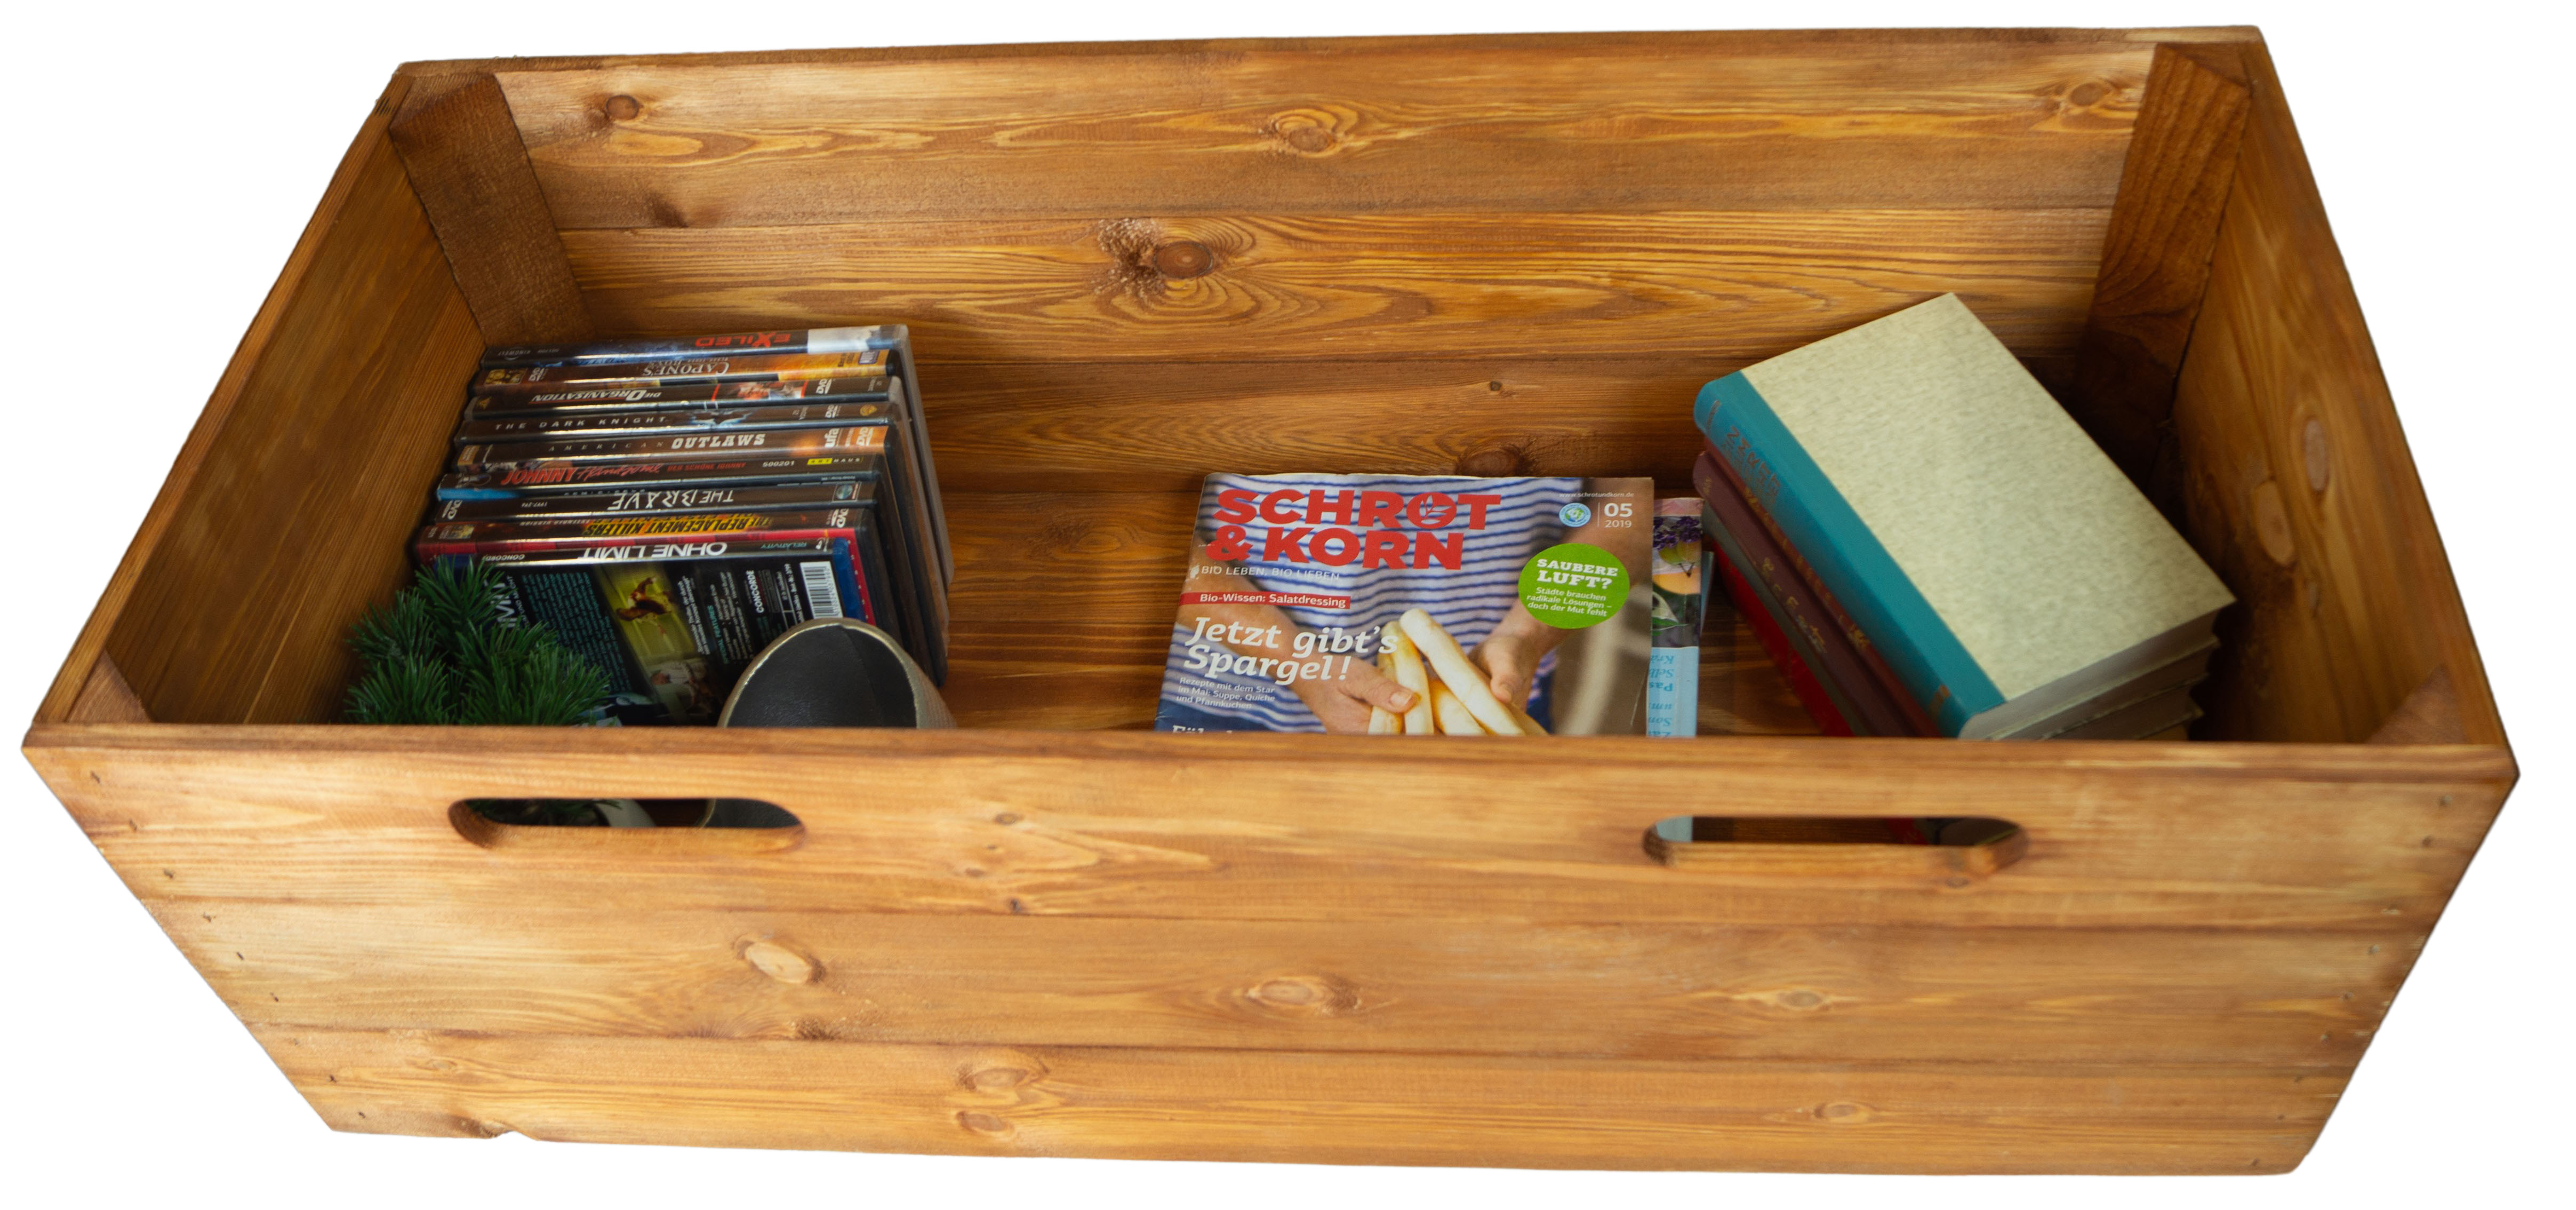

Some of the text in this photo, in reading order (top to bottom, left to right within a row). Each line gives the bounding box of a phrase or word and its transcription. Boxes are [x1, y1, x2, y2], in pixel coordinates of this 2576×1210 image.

[694, 331, 791, 347] EXILED
[531, 389, 647, 402] ORGANISATION
[495, 416, 667, 430] THE DARK KNIGHT
[548, 433, 766, 452] AMERICAN OUTLAWS
[762, 460, 796, 468] 500201
[500, 466, 580, 486] JOHNNY
[607, 490, 697, 511] BRAVE
[699, 490, 734, 504] THE
[1212, 489, 1501, 530] SCHROT
[1604, 503, 1633, 518] 05
[586, 521, 645, 536] KILLERS
[648, 517, 748, 534] REPLACEMENT
[1604, 520, 1633, 528] 2019
[578, 542, 728, 560] OHNE LIMIT
[1205, 524, 1464, 570] & KORN
[1201, 566, 1222, 575] BIO
[1271, 568, 1295, 578] BIO
[1296, 569, 1340, 582] LIEBEN
[1536, 559, 1619, 577] SAUBERE
[1537, 570, 1613, 590] LUFT?
[746, 570, 764, 614] CONCORDE
[1535, 586, 1607, 602] Städte brauchen
[1199, 593, 1347, 609] Bio-Wissen: Salatdressing
[1526, 595, 1563, 604] radikale
[1563, 597, 1605, 609] Lösungen
[1527, 601, 1608, 617] doch der Mut fehlt
[1185, 616, 1282, 649] Jetzt
[1179, 676, 1276, 694] Rezepte mit dem Star
[1176, 694, 1253, 710] und Pfannkuchen
[1178, 685, 1276, 703] im Mai: Suppe, Quiche
